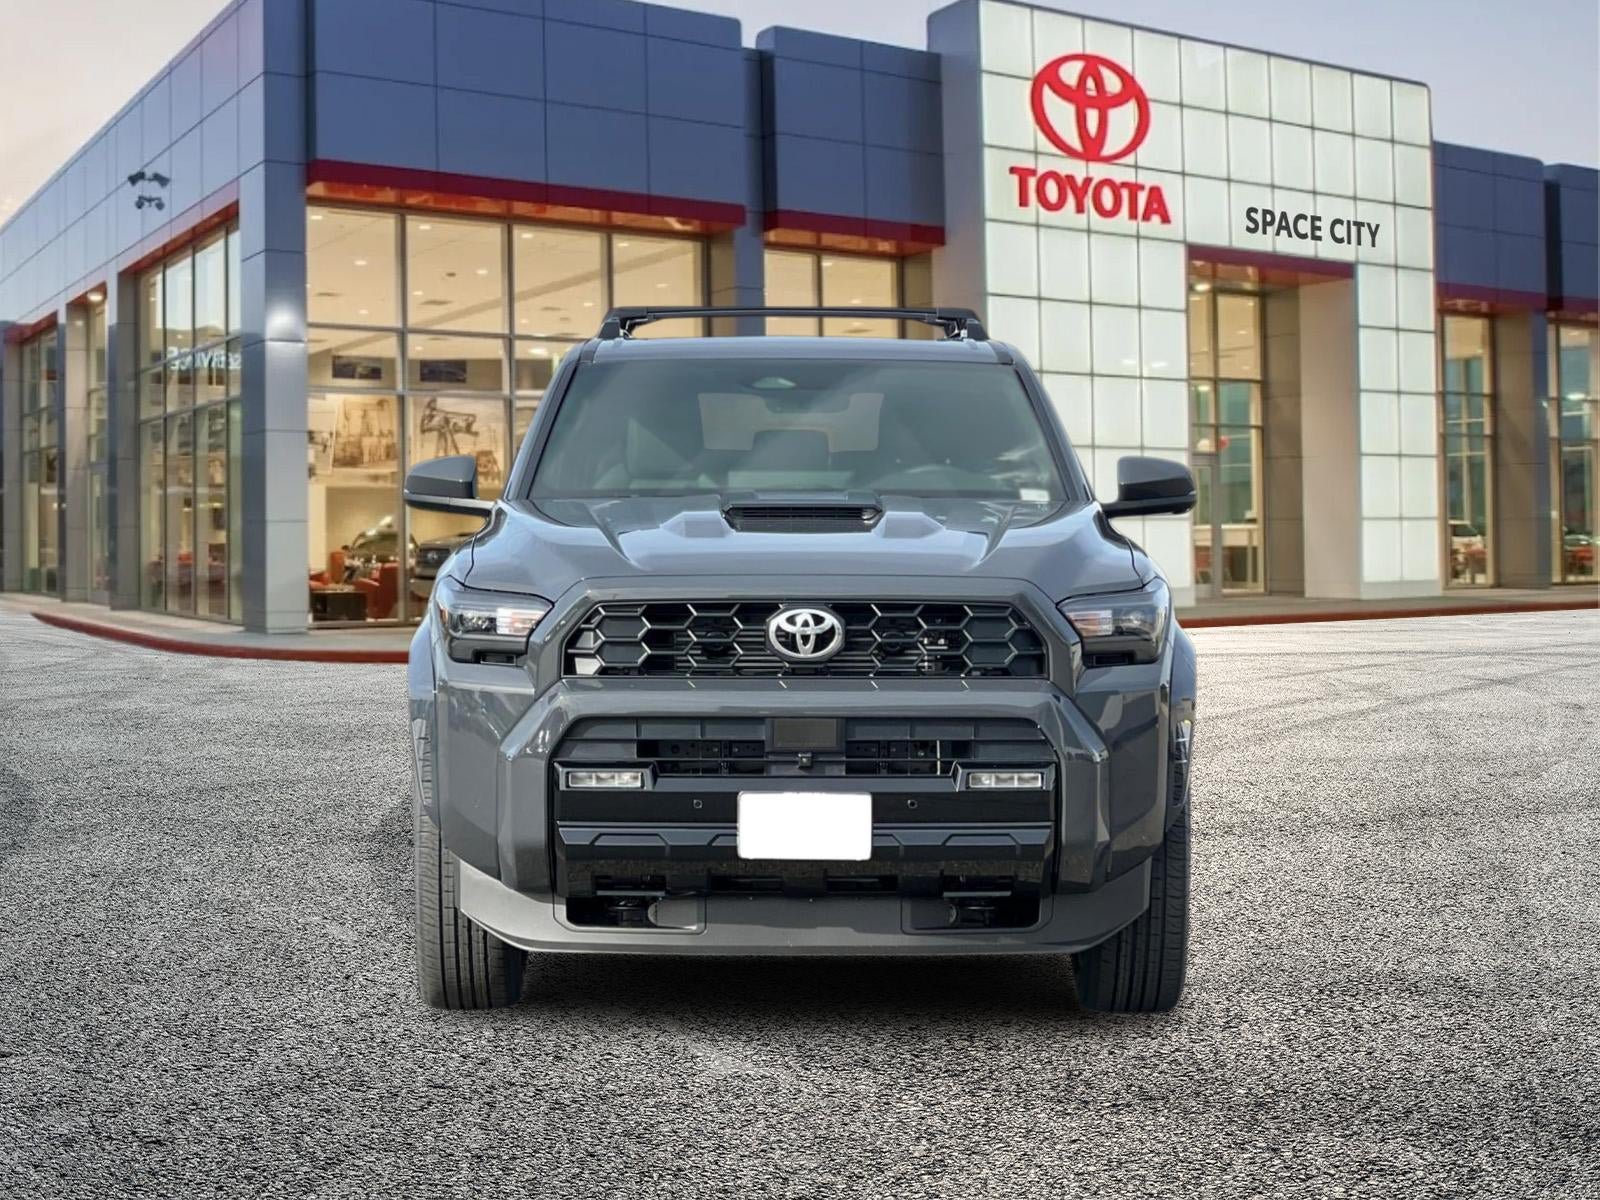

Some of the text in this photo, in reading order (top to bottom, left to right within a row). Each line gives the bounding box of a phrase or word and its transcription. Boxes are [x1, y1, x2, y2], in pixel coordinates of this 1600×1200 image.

[1009, 166, 1171, 224] TOYOTA
[1245, 206, 1380, 248] SPACE CITY
